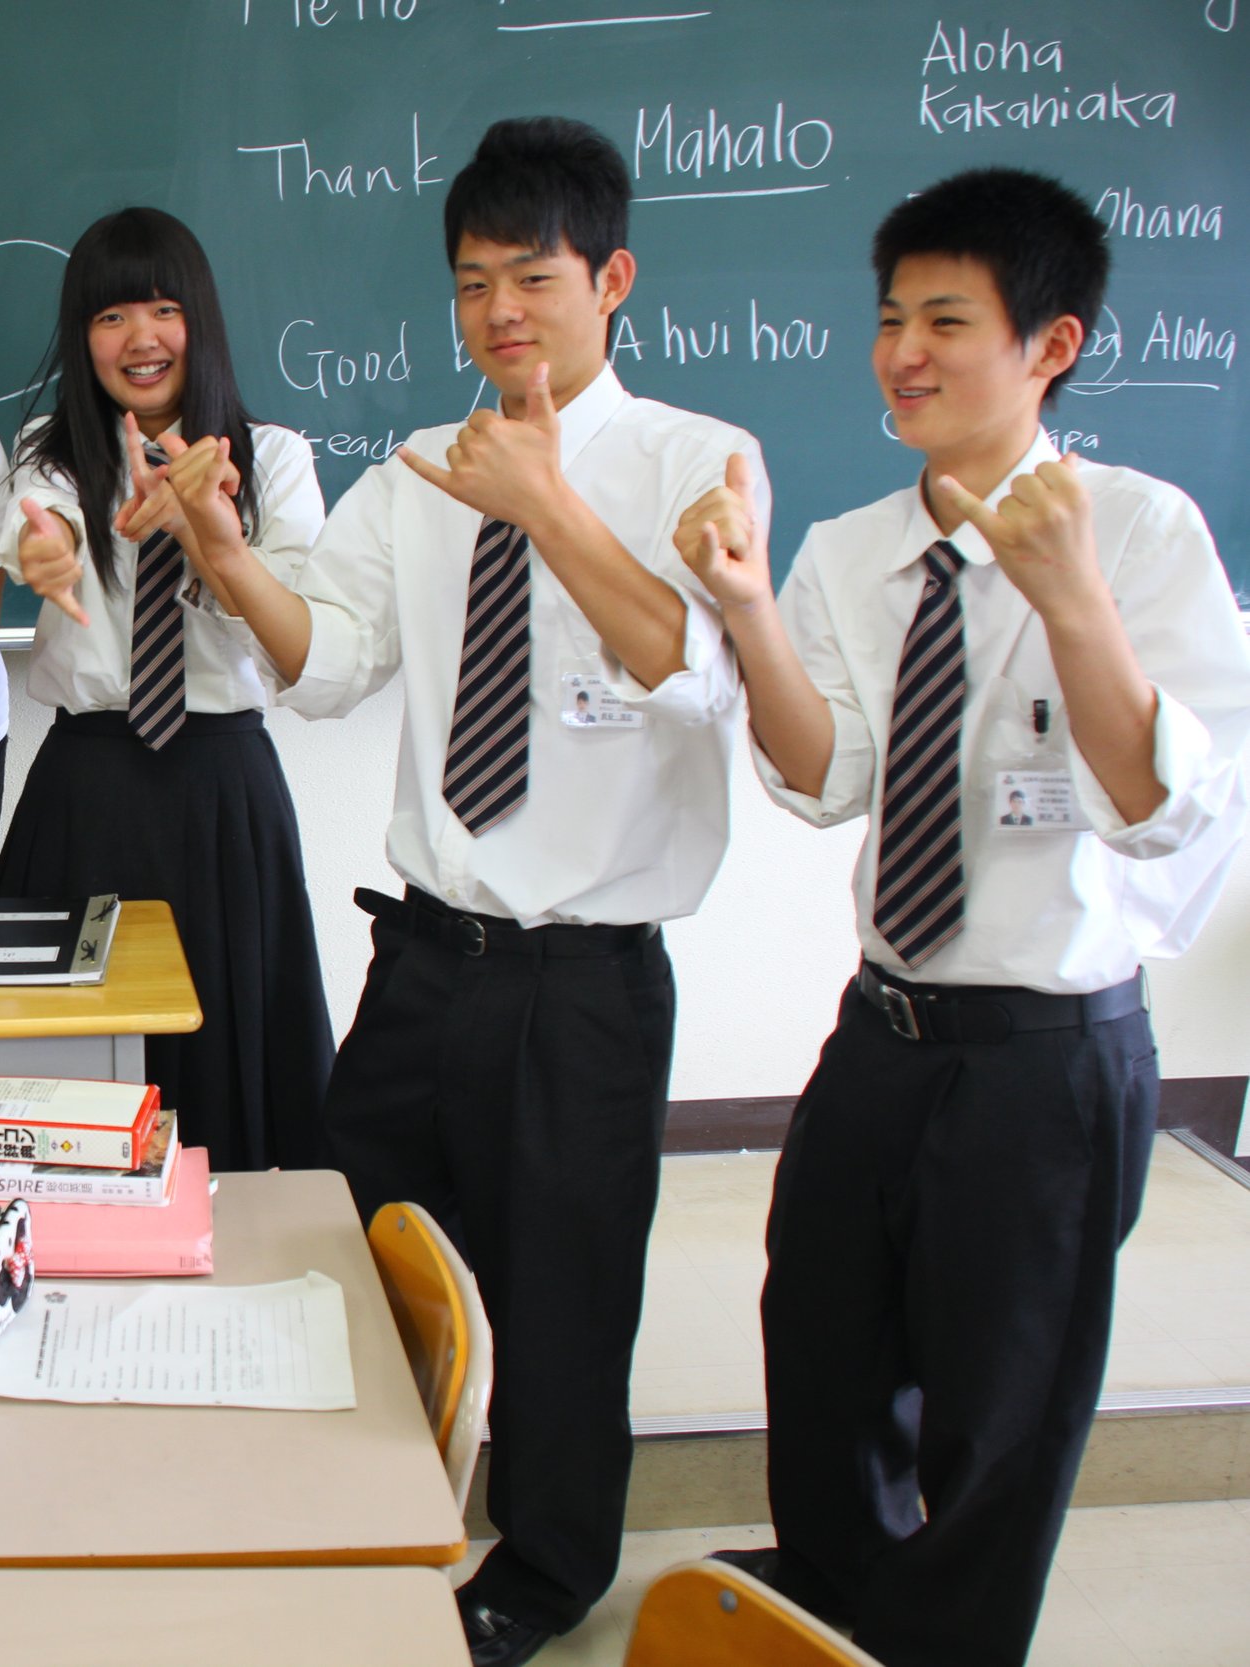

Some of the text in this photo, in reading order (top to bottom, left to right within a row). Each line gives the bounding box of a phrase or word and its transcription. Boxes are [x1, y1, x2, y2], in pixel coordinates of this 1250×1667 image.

[922, 19, 1063, 77] Aloha
[237, 101, 834, 201] Thank Mahalo
[278, 319, 411, 399] Good
[751, 298, 830, 362] hou
[1141, 310, 1237, 371] Aloha
